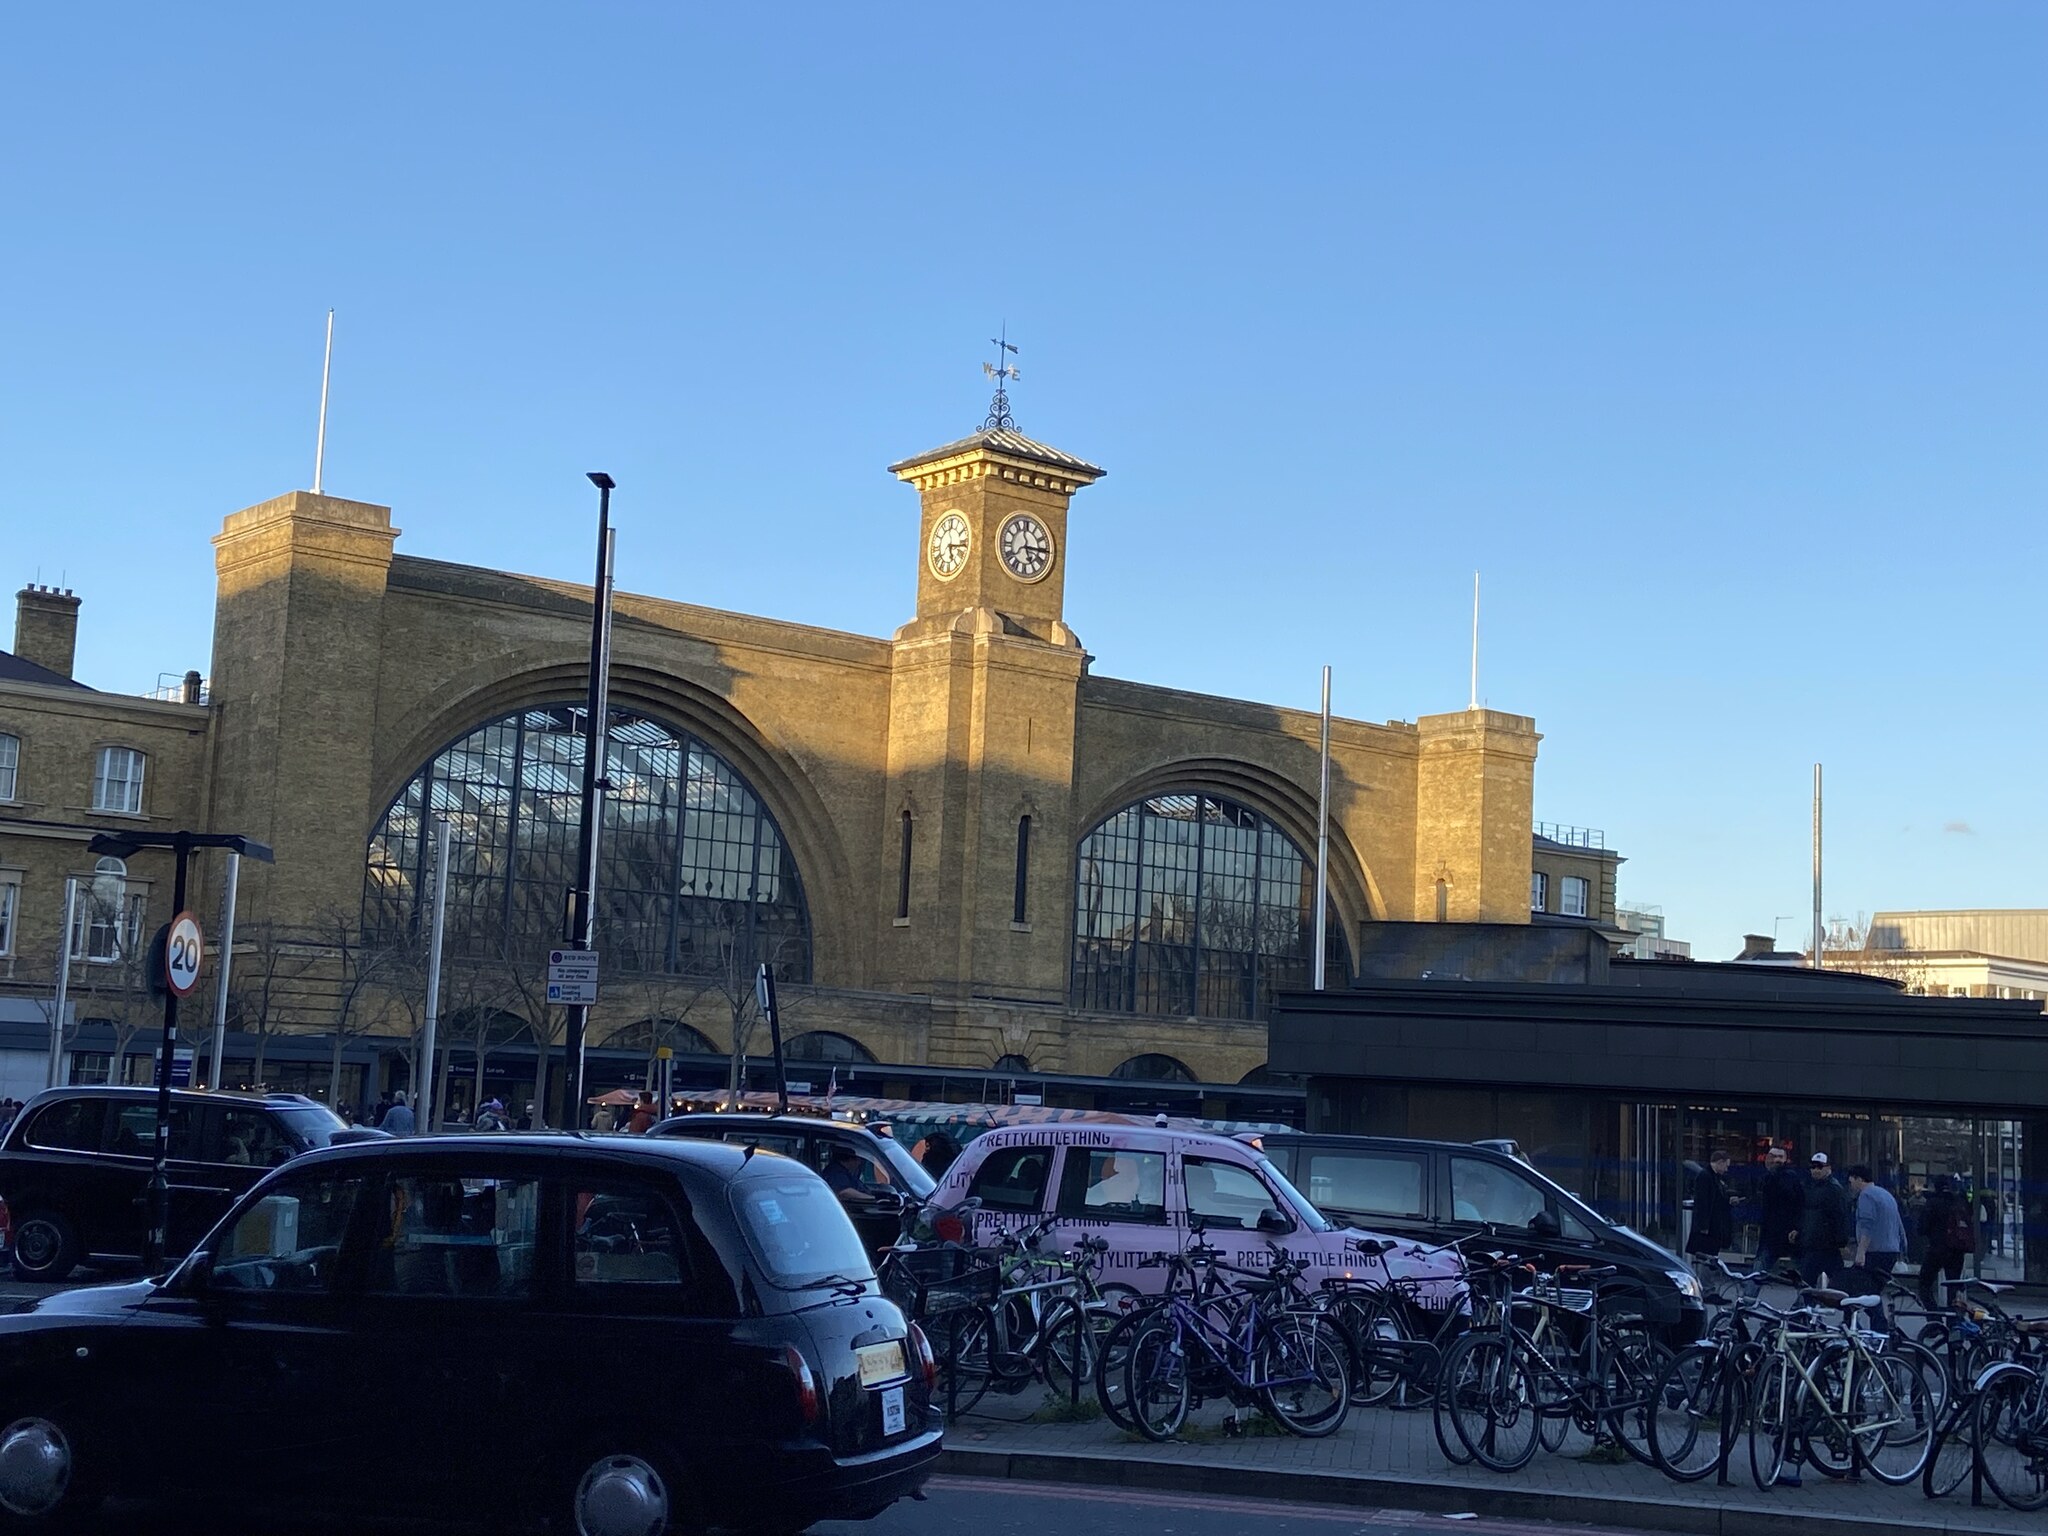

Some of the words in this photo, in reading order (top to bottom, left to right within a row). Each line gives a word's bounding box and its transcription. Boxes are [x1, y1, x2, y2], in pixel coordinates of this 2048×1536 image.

[172, 935, 198, 973] 20
[979, 1132, 1111, 1147] PRETTYLITTLETHING
[1237, 1251, 1377, 1268] PRETLITTLETHING
